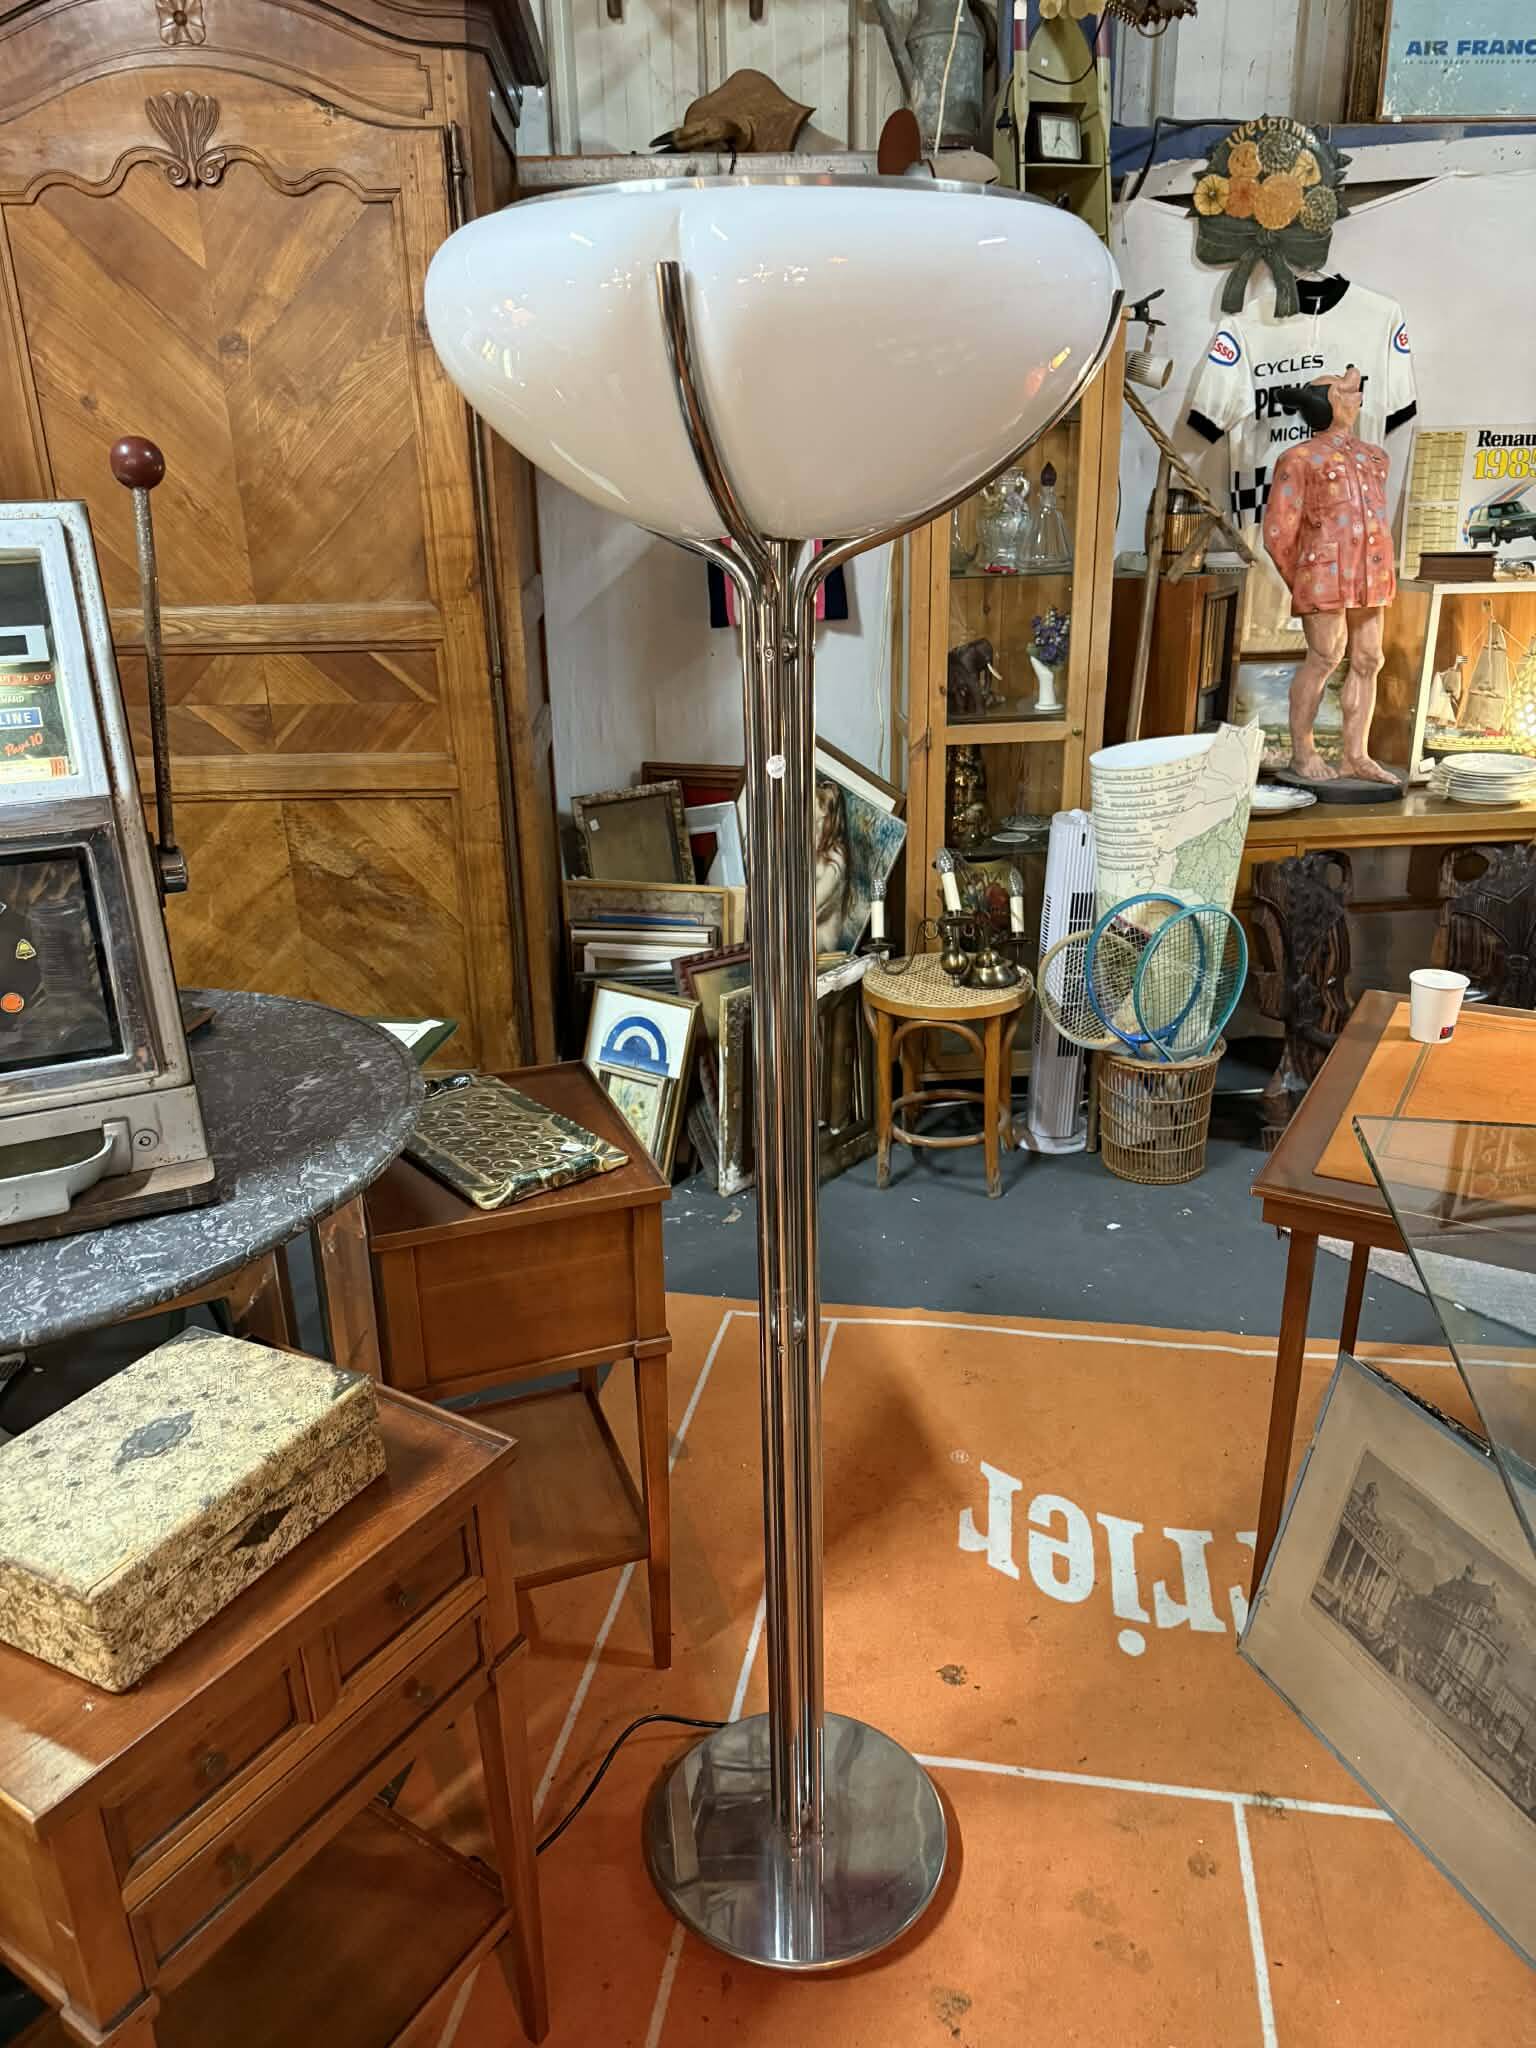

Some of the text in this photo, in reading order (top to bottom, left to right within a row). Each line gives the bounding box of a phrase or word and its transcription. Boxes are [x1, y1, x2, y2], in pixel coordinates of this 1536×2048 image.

[1405, 40, 1448, 56] AIR
[1213, 338, 1235, 361] SSO
[1253, 355, 1324, 377] CYCLES
